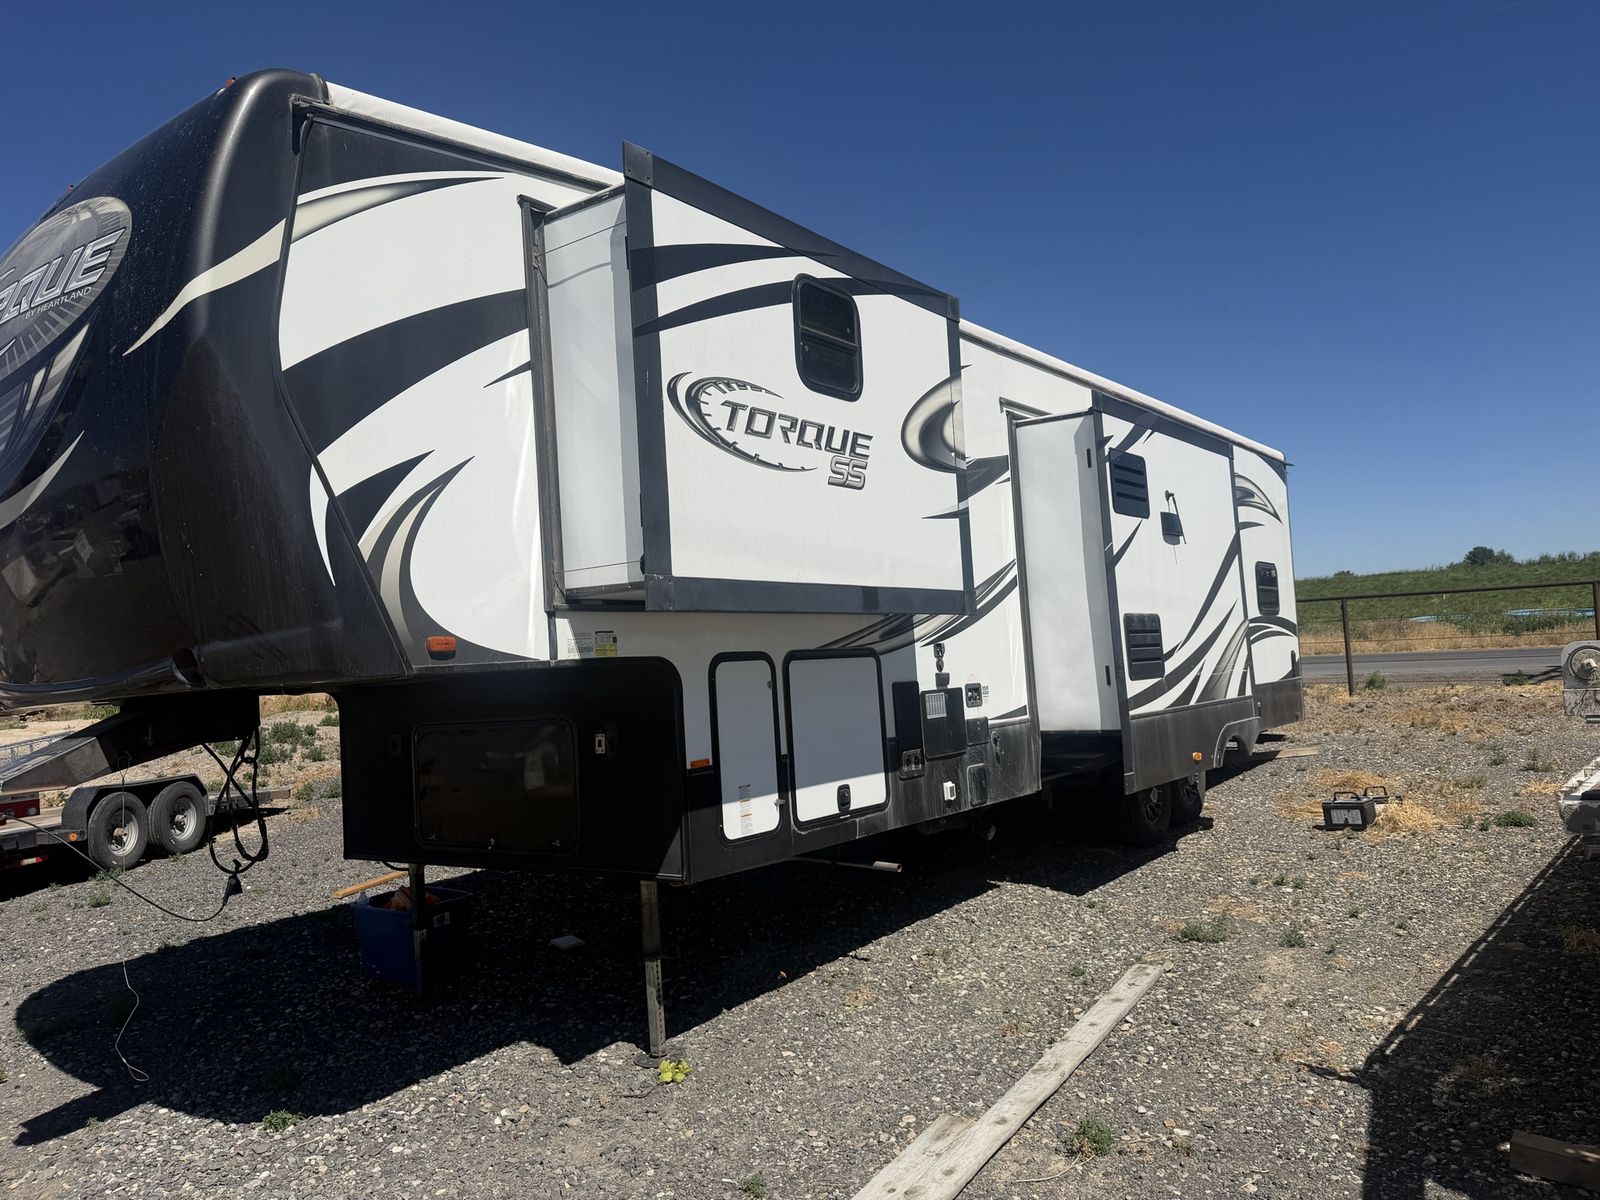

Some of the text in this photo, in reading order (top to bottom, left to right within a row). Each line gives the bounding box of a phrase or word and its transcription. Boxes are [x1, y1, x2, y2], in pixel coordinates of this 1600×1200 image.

[25, 286, 92, 319] BY HEARTLAND
[720, 400, 873, 460] TORQUE
[828, 455, 868, 490] SS
